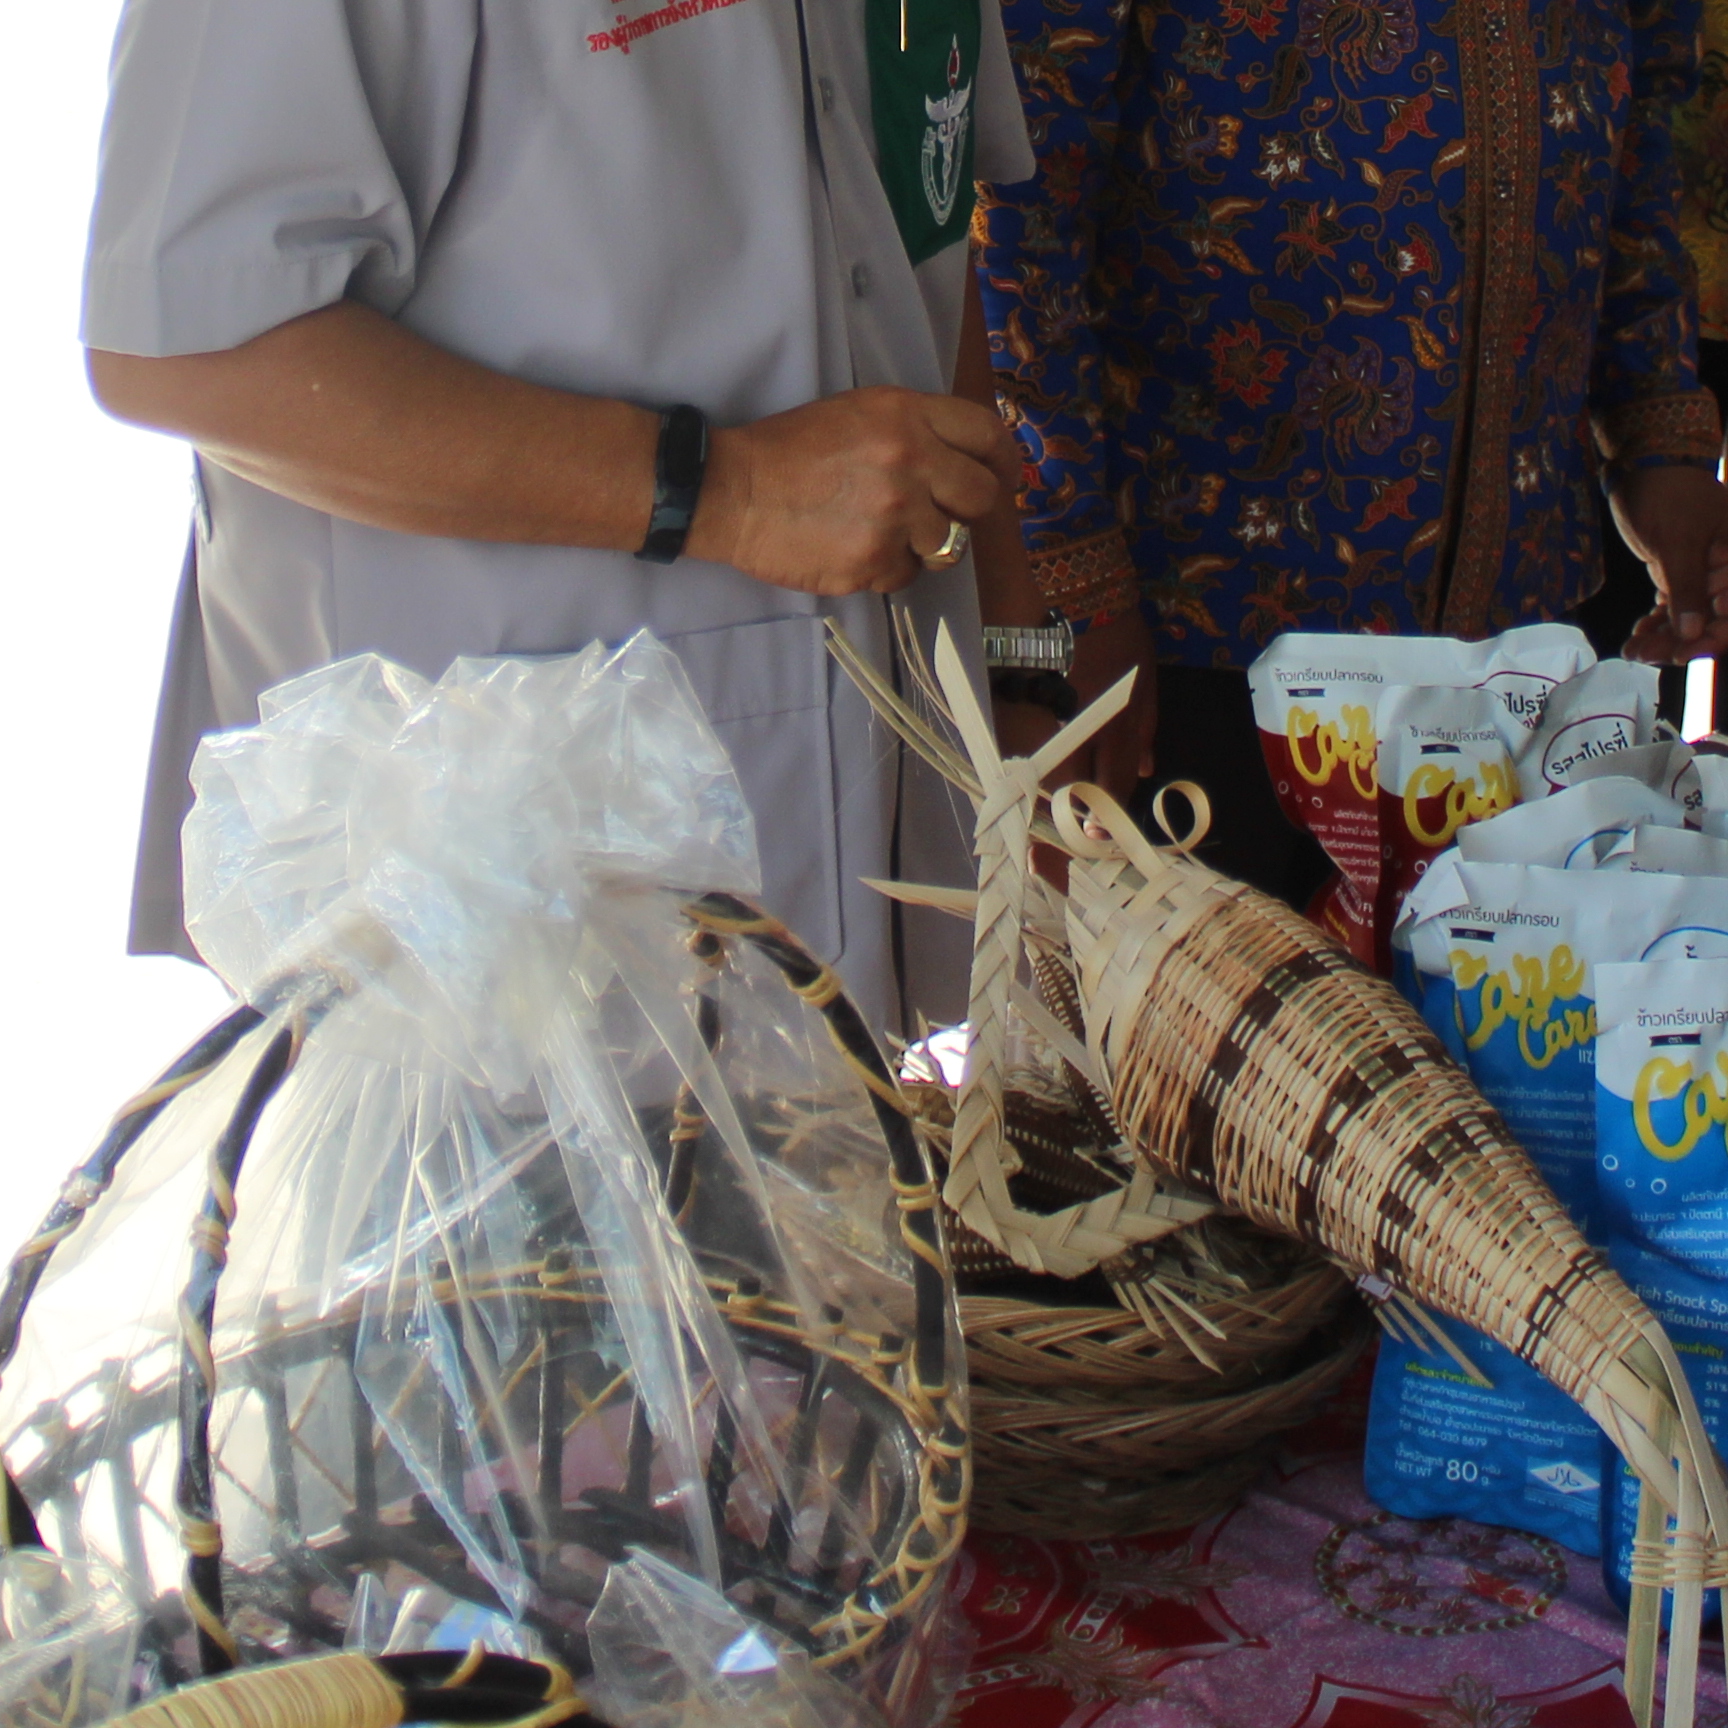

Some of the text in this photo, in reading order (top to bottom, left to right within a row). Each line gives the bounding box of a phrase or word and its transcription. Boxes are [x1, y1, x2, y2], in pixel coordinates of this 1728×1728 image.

[1635, 1284, 1661, 1301] Fish
[1665, 1290, 1706, 1310] Snack
[1446, 1459, 1478, 1482] 80
